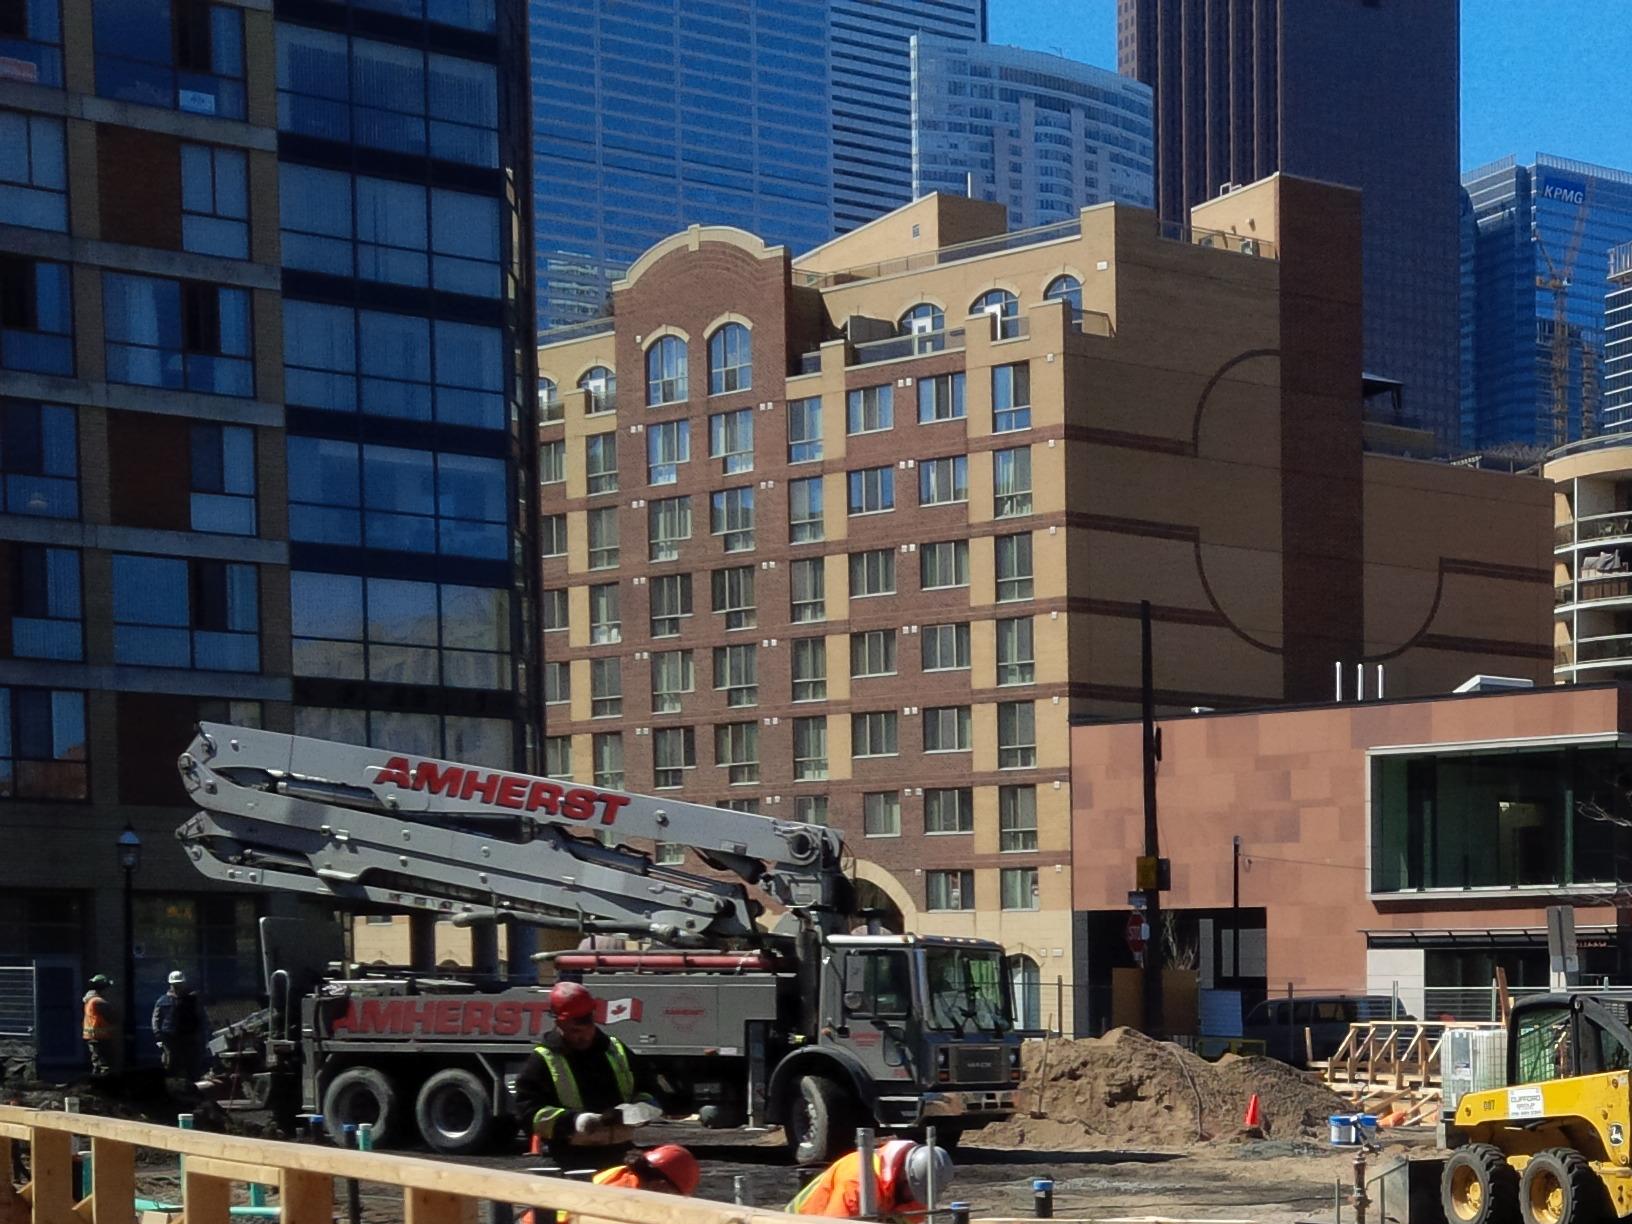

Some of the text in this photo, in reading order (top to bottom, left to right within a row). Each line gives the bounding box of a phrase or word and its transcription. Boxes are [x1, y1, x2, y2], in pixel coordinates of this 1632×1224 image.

[1544, 185, 1584, 205] KPMG
[373, 757, 631, 825] AMHERST
[332, 1000, 553, 1036] AMHERST
